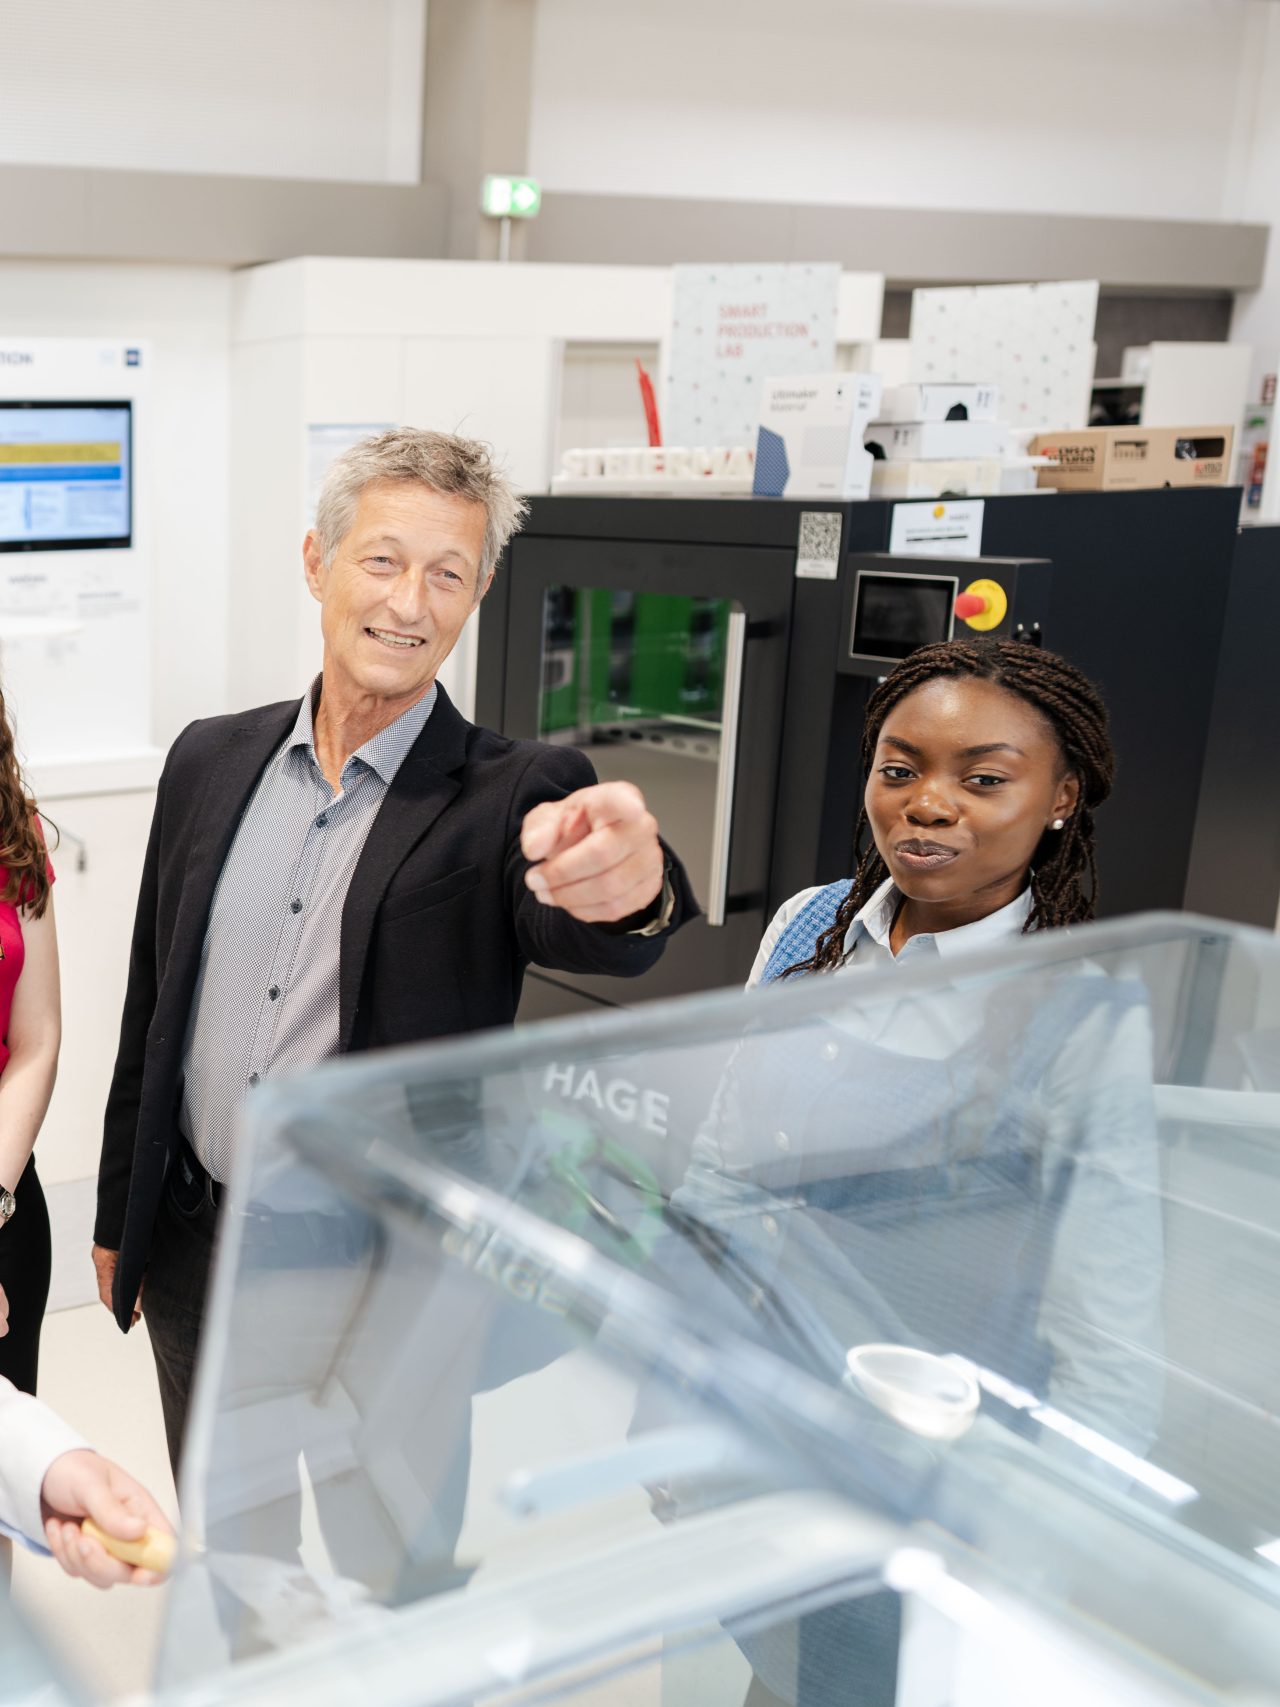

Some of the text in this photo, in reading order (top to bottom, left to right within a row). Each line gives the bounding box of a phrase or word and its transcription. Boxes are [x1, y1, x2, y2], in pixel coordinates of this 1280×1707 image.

[719, 303, 767, 318] SMART
[717, 322, 809, 338] PRODUCTION
[716, 342, 743, 358] LAB
[541, 1061, 670, 1139] HAGE
